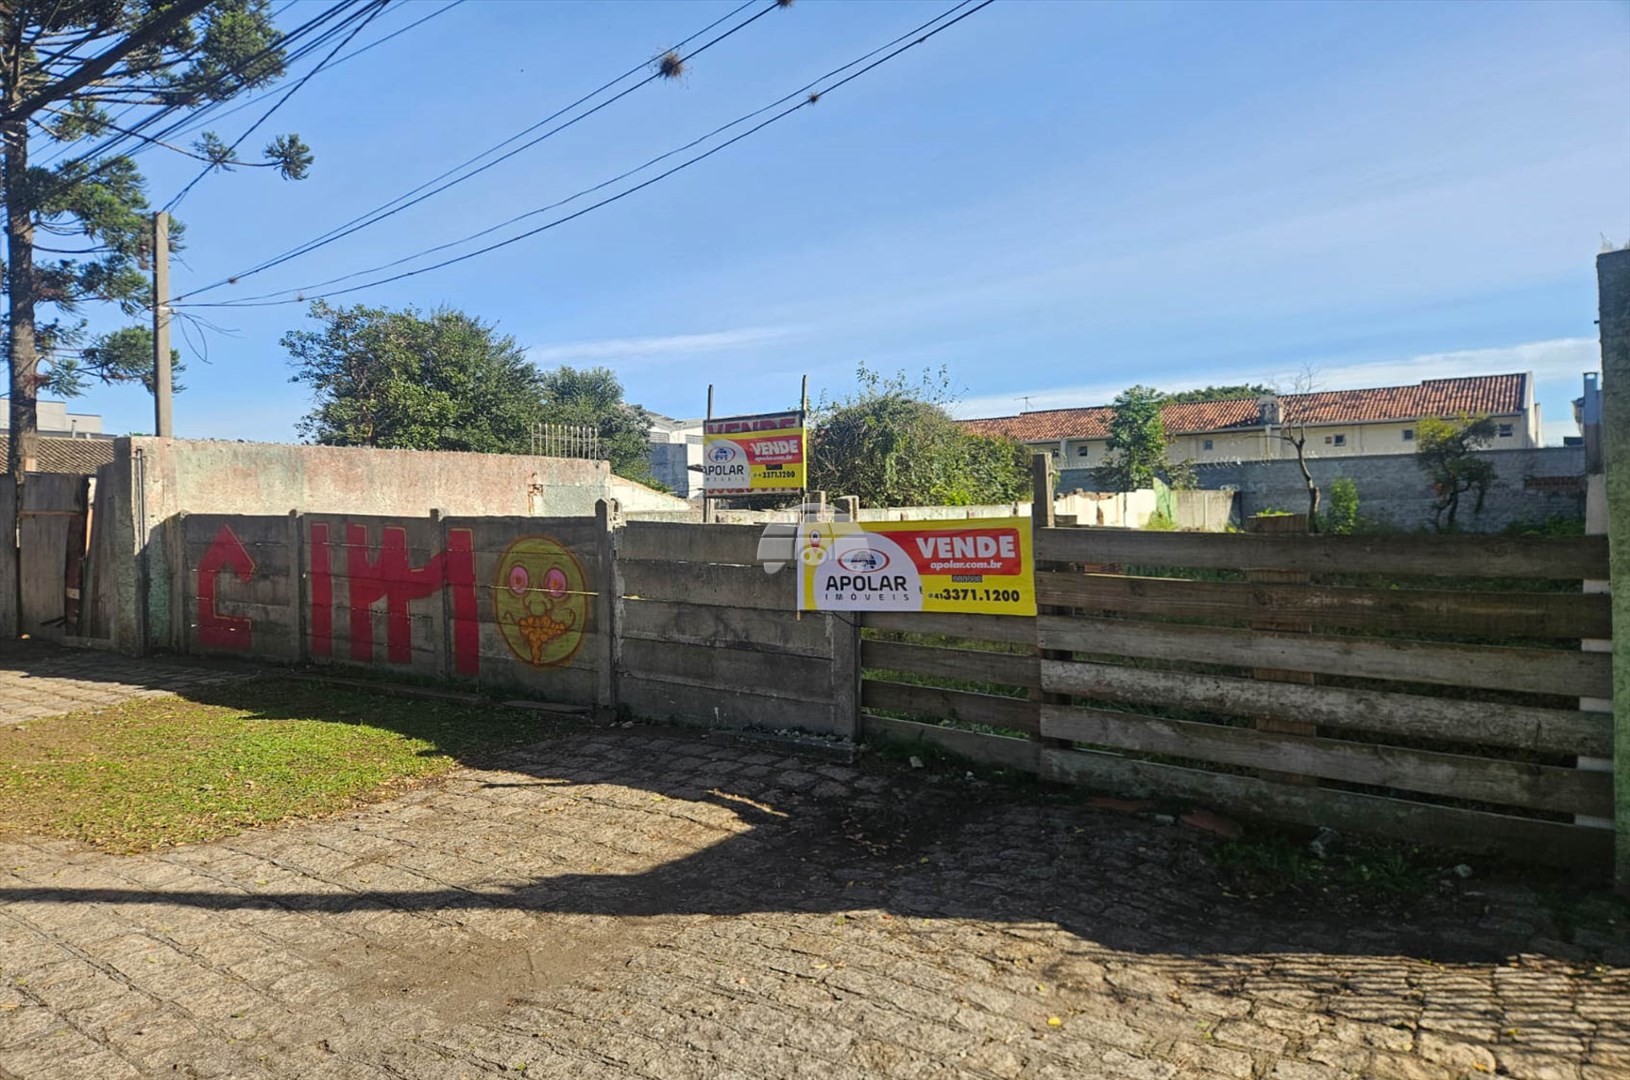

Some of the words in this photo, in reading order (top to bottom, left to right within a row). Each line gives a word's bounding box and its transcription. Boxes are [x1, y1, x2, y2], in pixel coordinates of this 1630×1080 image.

[751, 440, 798, 455] VENDE
[915, 535, 1016, 559] VENDE
[930, 560, 1003, 571] apolar.com.br
[825, 575, 908, 591] APOLAR
[825, 592, 910, 601] IMÓVEIS
[943, 588, 1020, 602] 3371.1200
